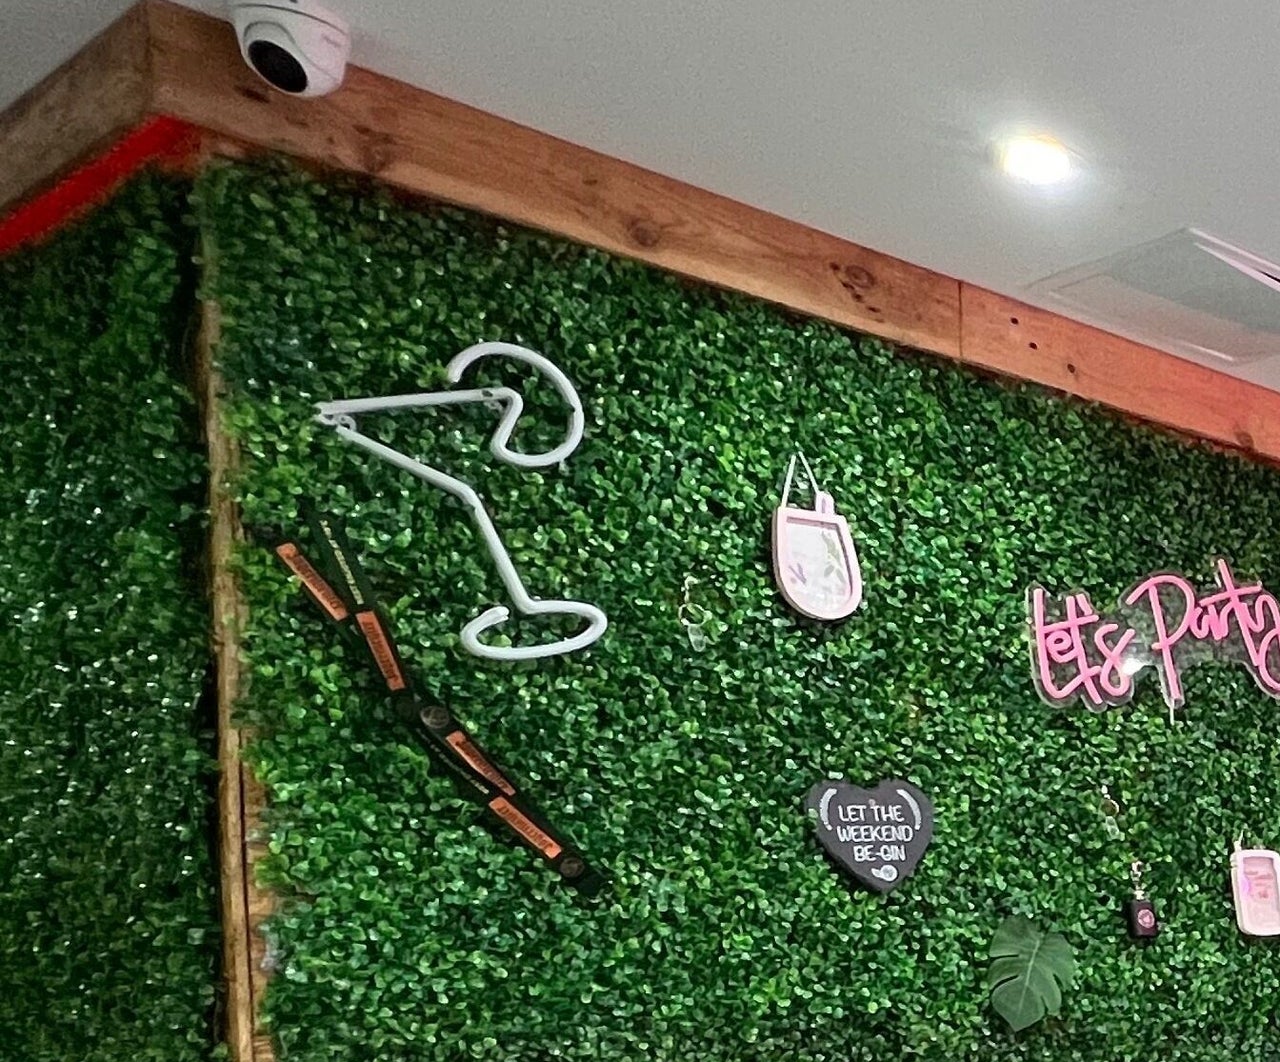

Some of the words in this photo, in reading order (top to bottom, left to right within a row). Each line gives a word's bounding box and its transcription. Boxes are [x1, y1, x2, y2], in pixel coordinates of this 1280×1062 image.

[838, 804, 866, 822] LET
[869, 804, 905, 822] THE
[836, 825, 914, 842] WEEKEND
